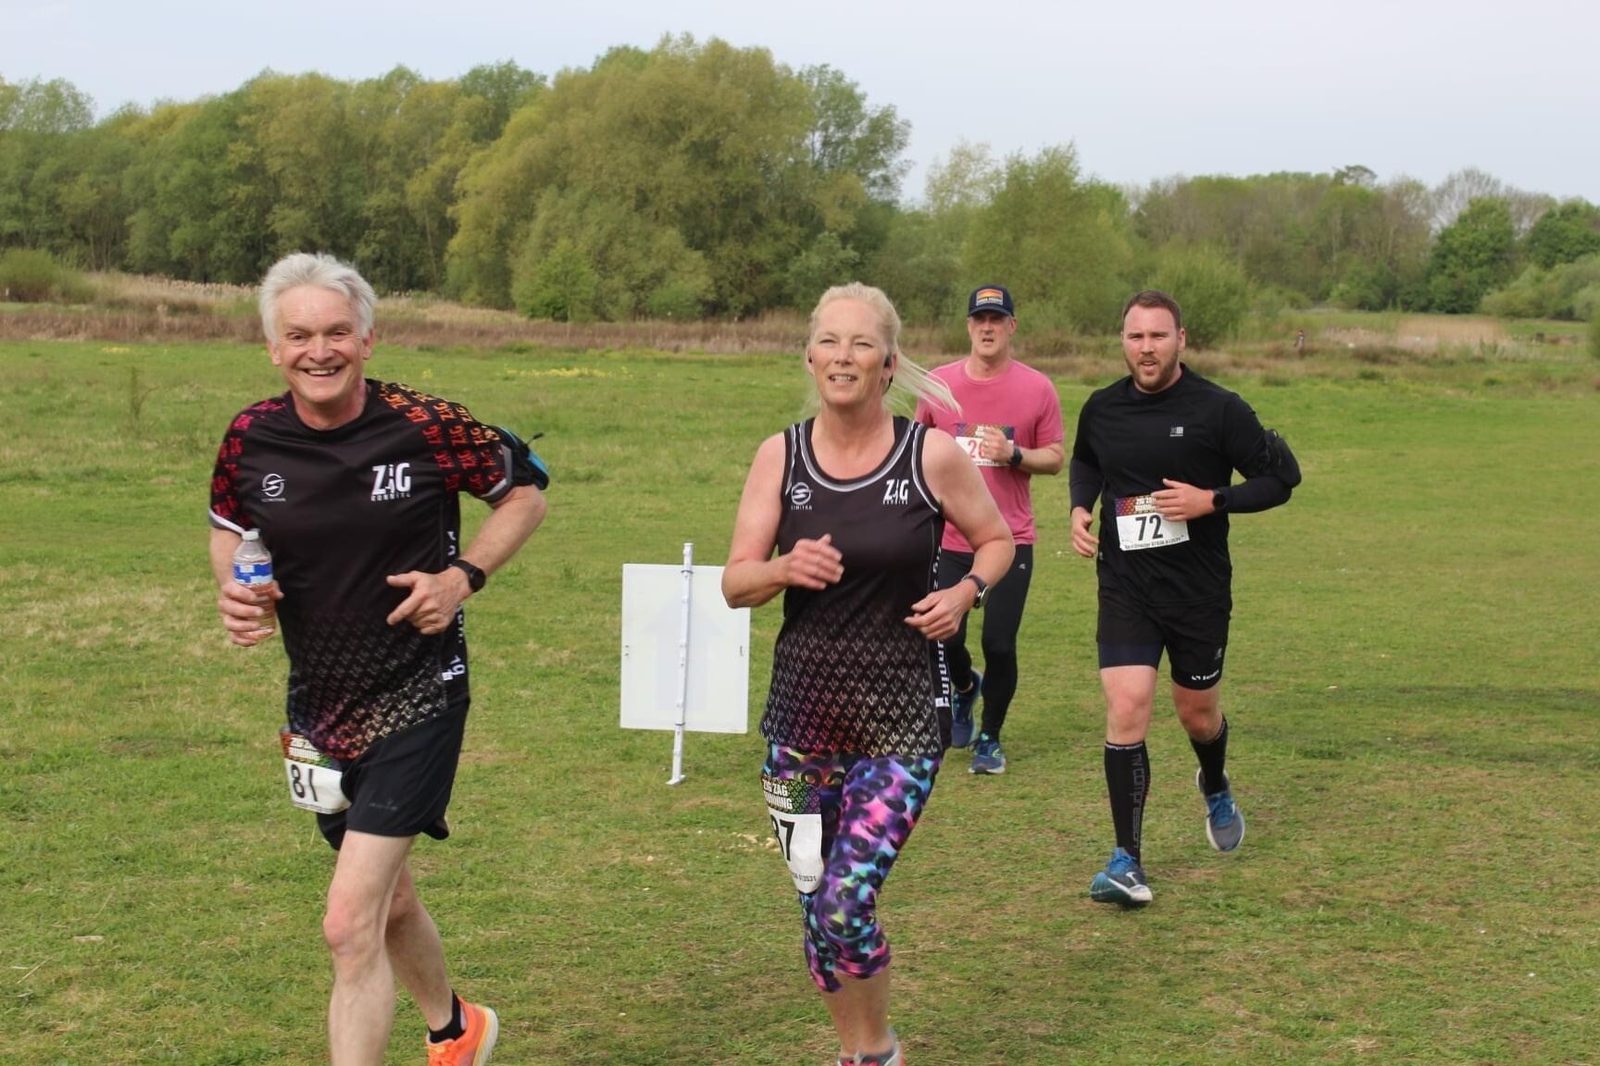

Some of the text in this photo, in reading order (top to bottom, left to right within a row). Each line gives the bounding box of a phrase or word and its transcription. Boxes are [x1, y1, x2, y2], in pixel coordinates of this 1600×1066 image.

[1135, 514, 1163, 541] 72
[290, 764, 318, 802] 81
[773, 783, 788, 796] ZAG
